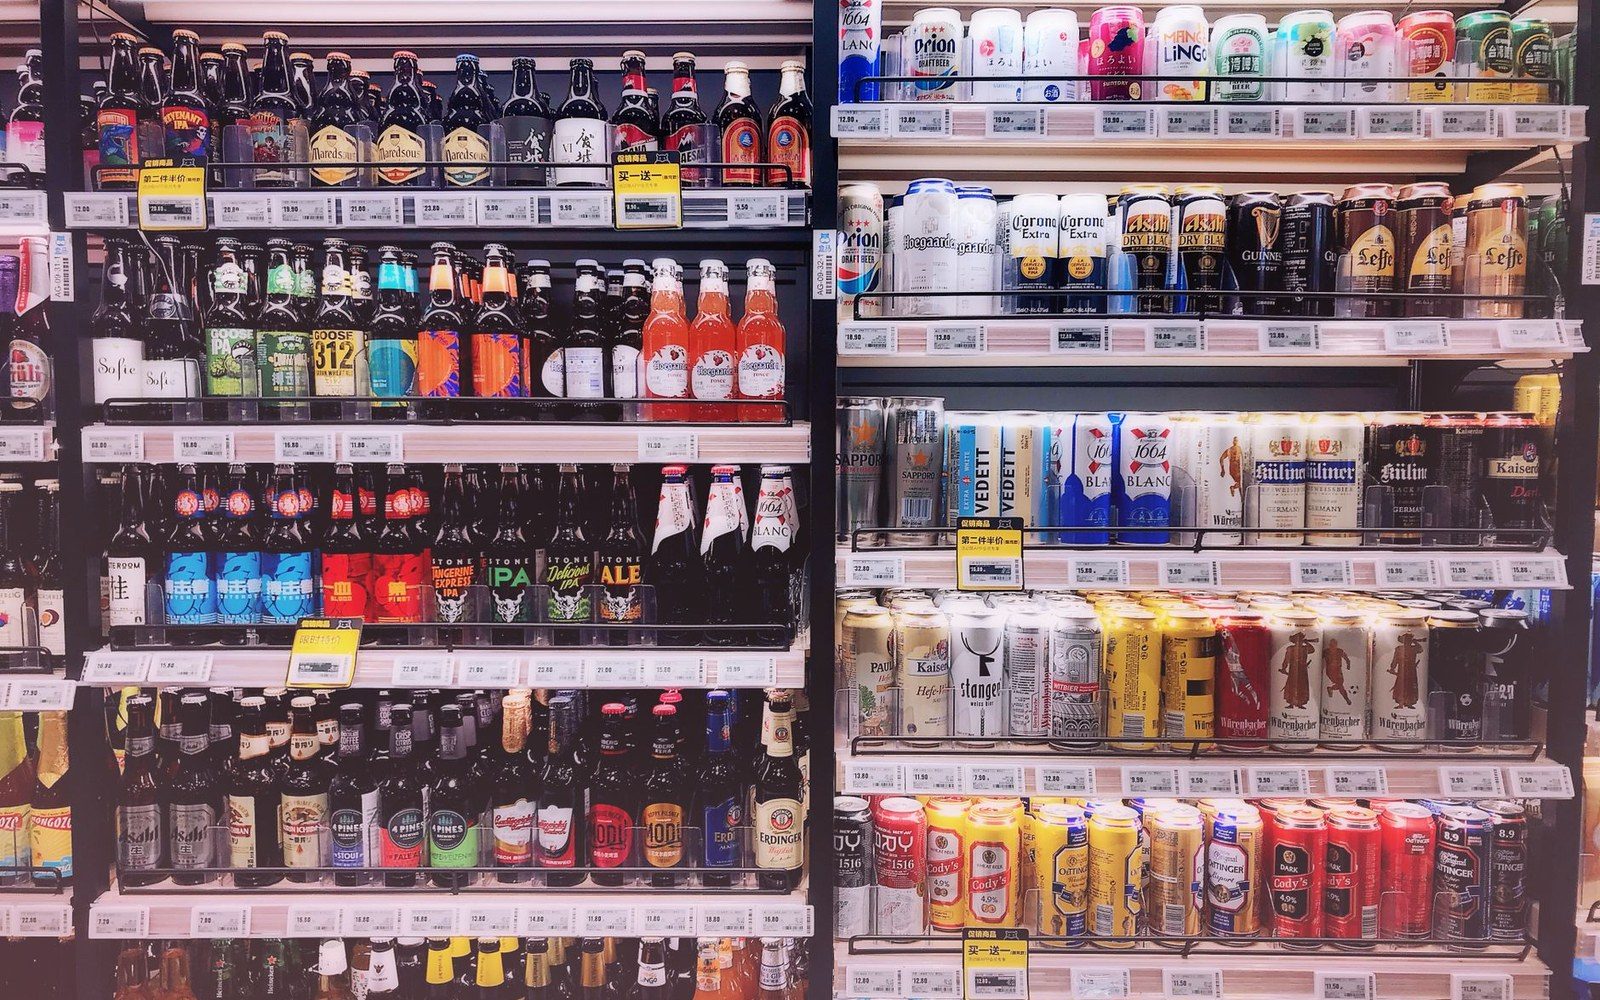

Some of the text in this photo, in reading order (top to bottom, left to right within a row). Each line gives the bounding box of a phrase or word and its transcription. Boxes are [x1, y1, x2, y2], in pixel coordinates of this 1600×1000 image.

[843, 10, 870, 25] 1664
[936, 58, 949, 67] BEER
[1097, 56, 1137, 66] ほろよい
[174, 121, 189, 129] IPA
[562, 144, 572, 153] VI
[618, 170, 662, 181] 买一送一
[1012, 215, 1056, 231] Corona
[1061, 215, 1104, 231] Corona
[1022, 229, 1050, 239] Extra
[1070, 229, 1098, 239] Extra
[1123, 237, 1142, 246] DRY
[1179, 237, 1199, 246] DRY
[861, 254, 874, 263] BEER
[1358, 248, 1392, 271] Leffe
[1486, 248, 1523, 271] Leffe
[210, 329, 254, 339] GOOSE
[314, 331, 354, 339] GOOSE
[212, 339, 230, 355] IPA
[316, 341, 354, 369] 312
[98, 358, 136, 381] Sofie
[146, 371, 175, 390] Sofie
[1134, 442, 1166, 459] 1664
[835, 454, 882, 466] SAPPOR
[975, 448, 989, 514] VEDETT
[1002, 448, 1016, 512] VEDETT
[961, 536, 1003, 545] 第二件半价
[489, 568, 531, 587] IPA
[548, 563, 590, 581] Delicious
[601, 565, 641, 584] ALE
[435, 576, 471, 588] EXPRESS
[560, 578, 580, 590] IPA
[443, 588, 458, 597] IPA
[917, 662, 948, 673] Kaiser
[1221, 717, 1266, 730] Würenbacher
[1271, 718, 1317, 731] Würenbacher
[1379, 717, 1425, 731] Würenbacher
[760, 832, 801, 844] ERDINGER
[1444, 832, 1459, 842] 8.9
[1499, 829, 1514, 838] 8.9
[839, 859, 861, 869] 1516
[892, 859, 914, 869] 1516
[1280, 864, 1298, 873] DARK
[934, 879, 950, 887] 4.9%
[972, 876, 1006, 890] Cody's
[1274, 877, 1308, 889] Cody's
[1280, 894, 1297, 904] 4.9%
[968, 945, 1011, 956] 买一送一
